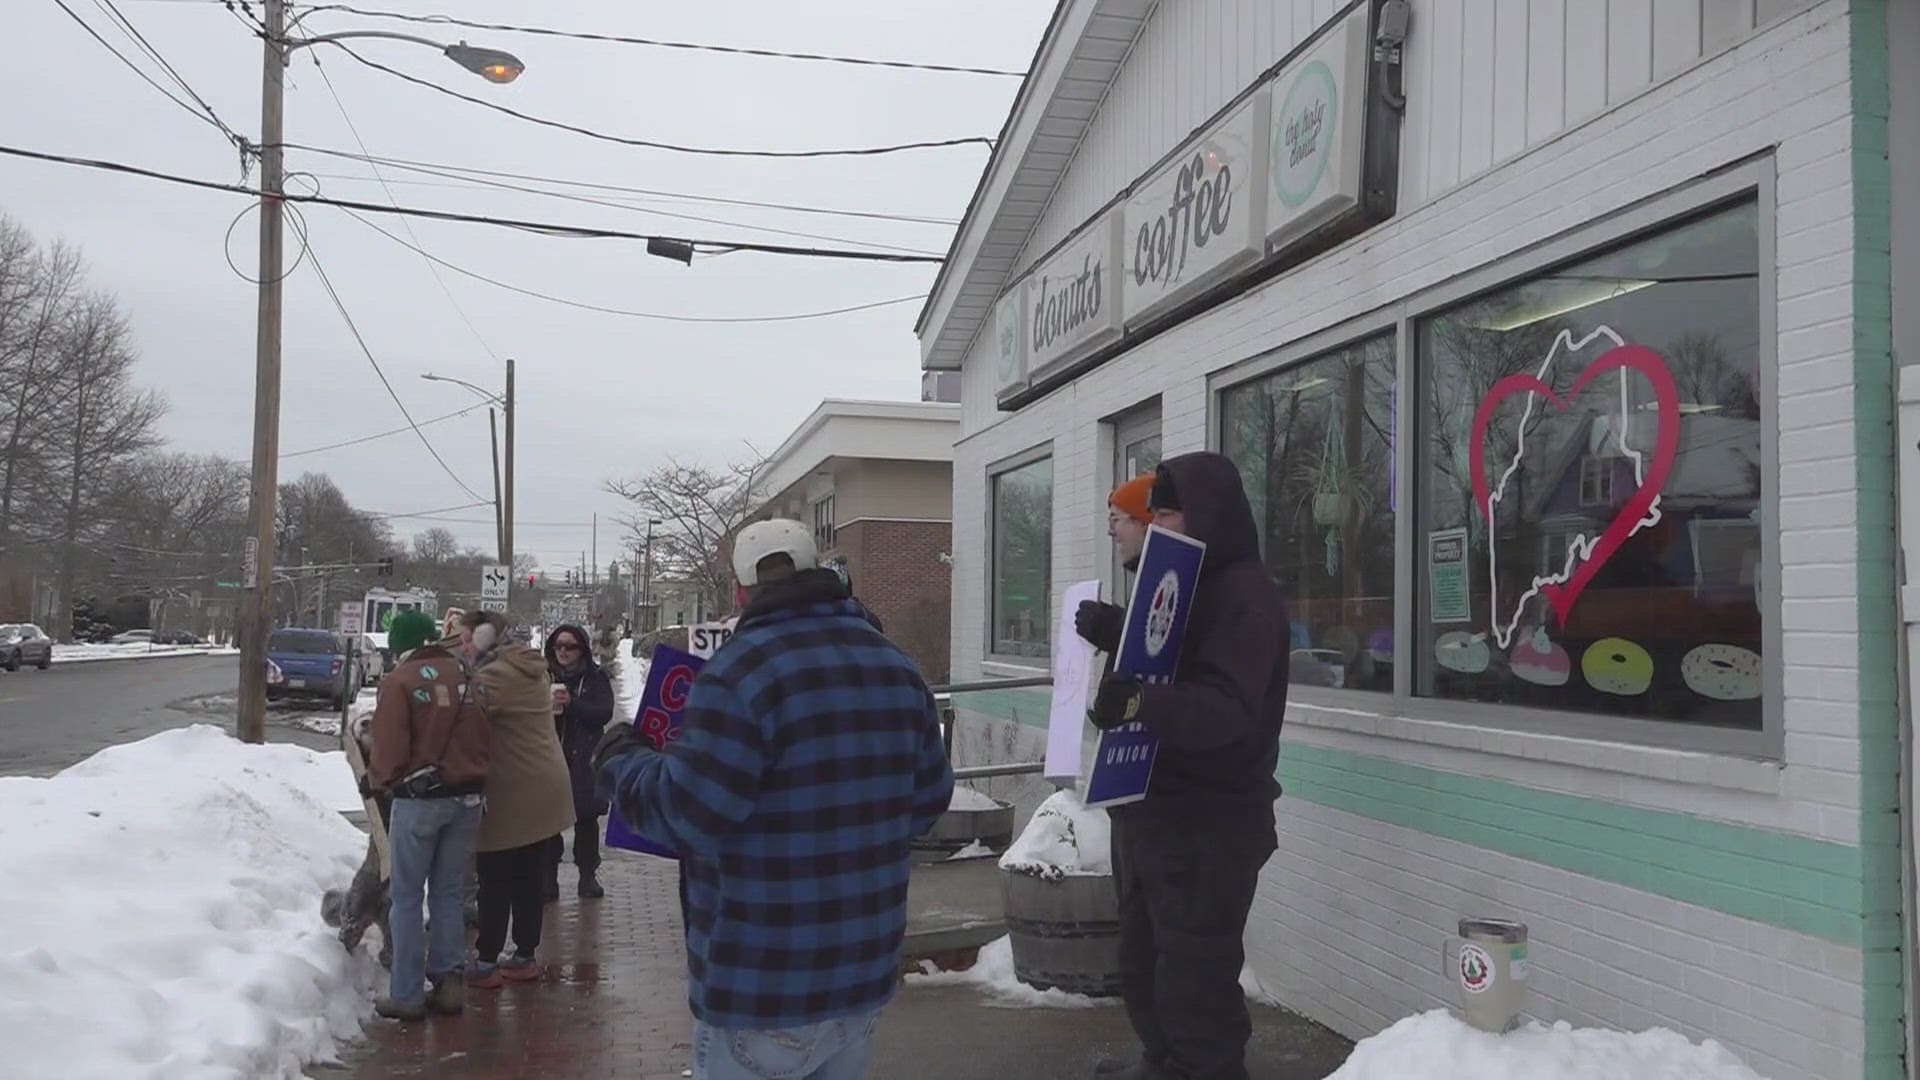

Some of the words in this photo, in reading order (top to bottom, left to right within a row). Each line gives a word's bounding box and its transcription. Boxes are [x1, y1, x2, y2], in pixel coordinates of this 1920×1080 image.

[1290, 140, 1316, 169] donut
[1134, 151, 1232, 289] coffee
[1033, 253, 1101, 352] donuts
[483, 588, 505, 596] ONLY
[483, 602, 505, 612] END
[1106, 744, 1150, 766] UNION
